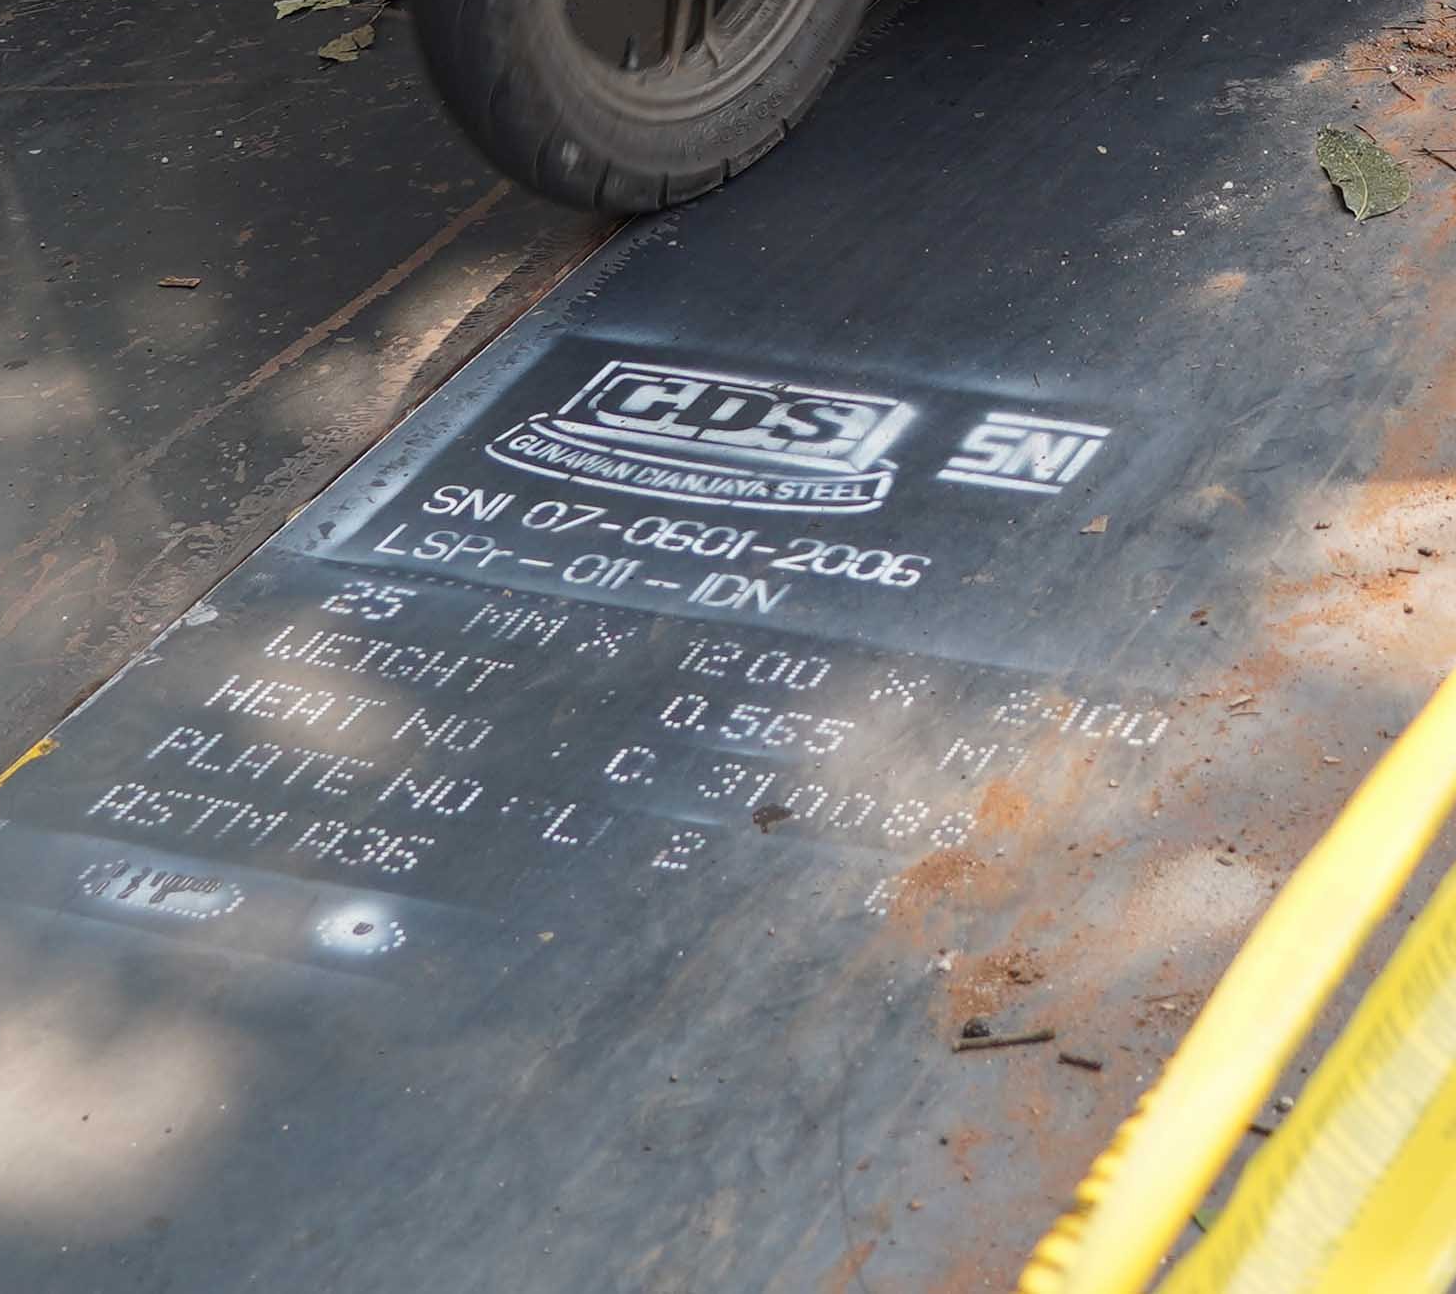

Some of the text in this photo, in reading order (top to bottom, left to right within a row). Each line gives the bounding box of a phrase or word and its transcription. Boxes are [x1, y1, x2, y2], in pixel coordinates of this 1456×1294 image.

[508, 431, 633, 487] GUNAWAN
[775, 477, 873, 502] STEEL
[948, 422, 1106, 483] SNI
[374, 522, 515, 570] LSPr
[561, 553, 645, 593] 011
[686, 572, 794, 615] IDN
[421, 484, 934, 589] SNI 07-0601-2006
[264, 624, 515, 693] WEIGHT
[658, 693, 856, 755] 0.565
[460, 601, 569, 648] MM
[575, 617, 638, 659] X
[676, 637, 832, 693] 1200
[869, 668, 931, 707] X
[204, 673, 388, 731] HEAT
[391, 708, 494, 752] NO
[147, 725, 375, 796] PLATE
[377, 767, 484, 815] NO
[87, 782, 435, 874] ASTM A36
